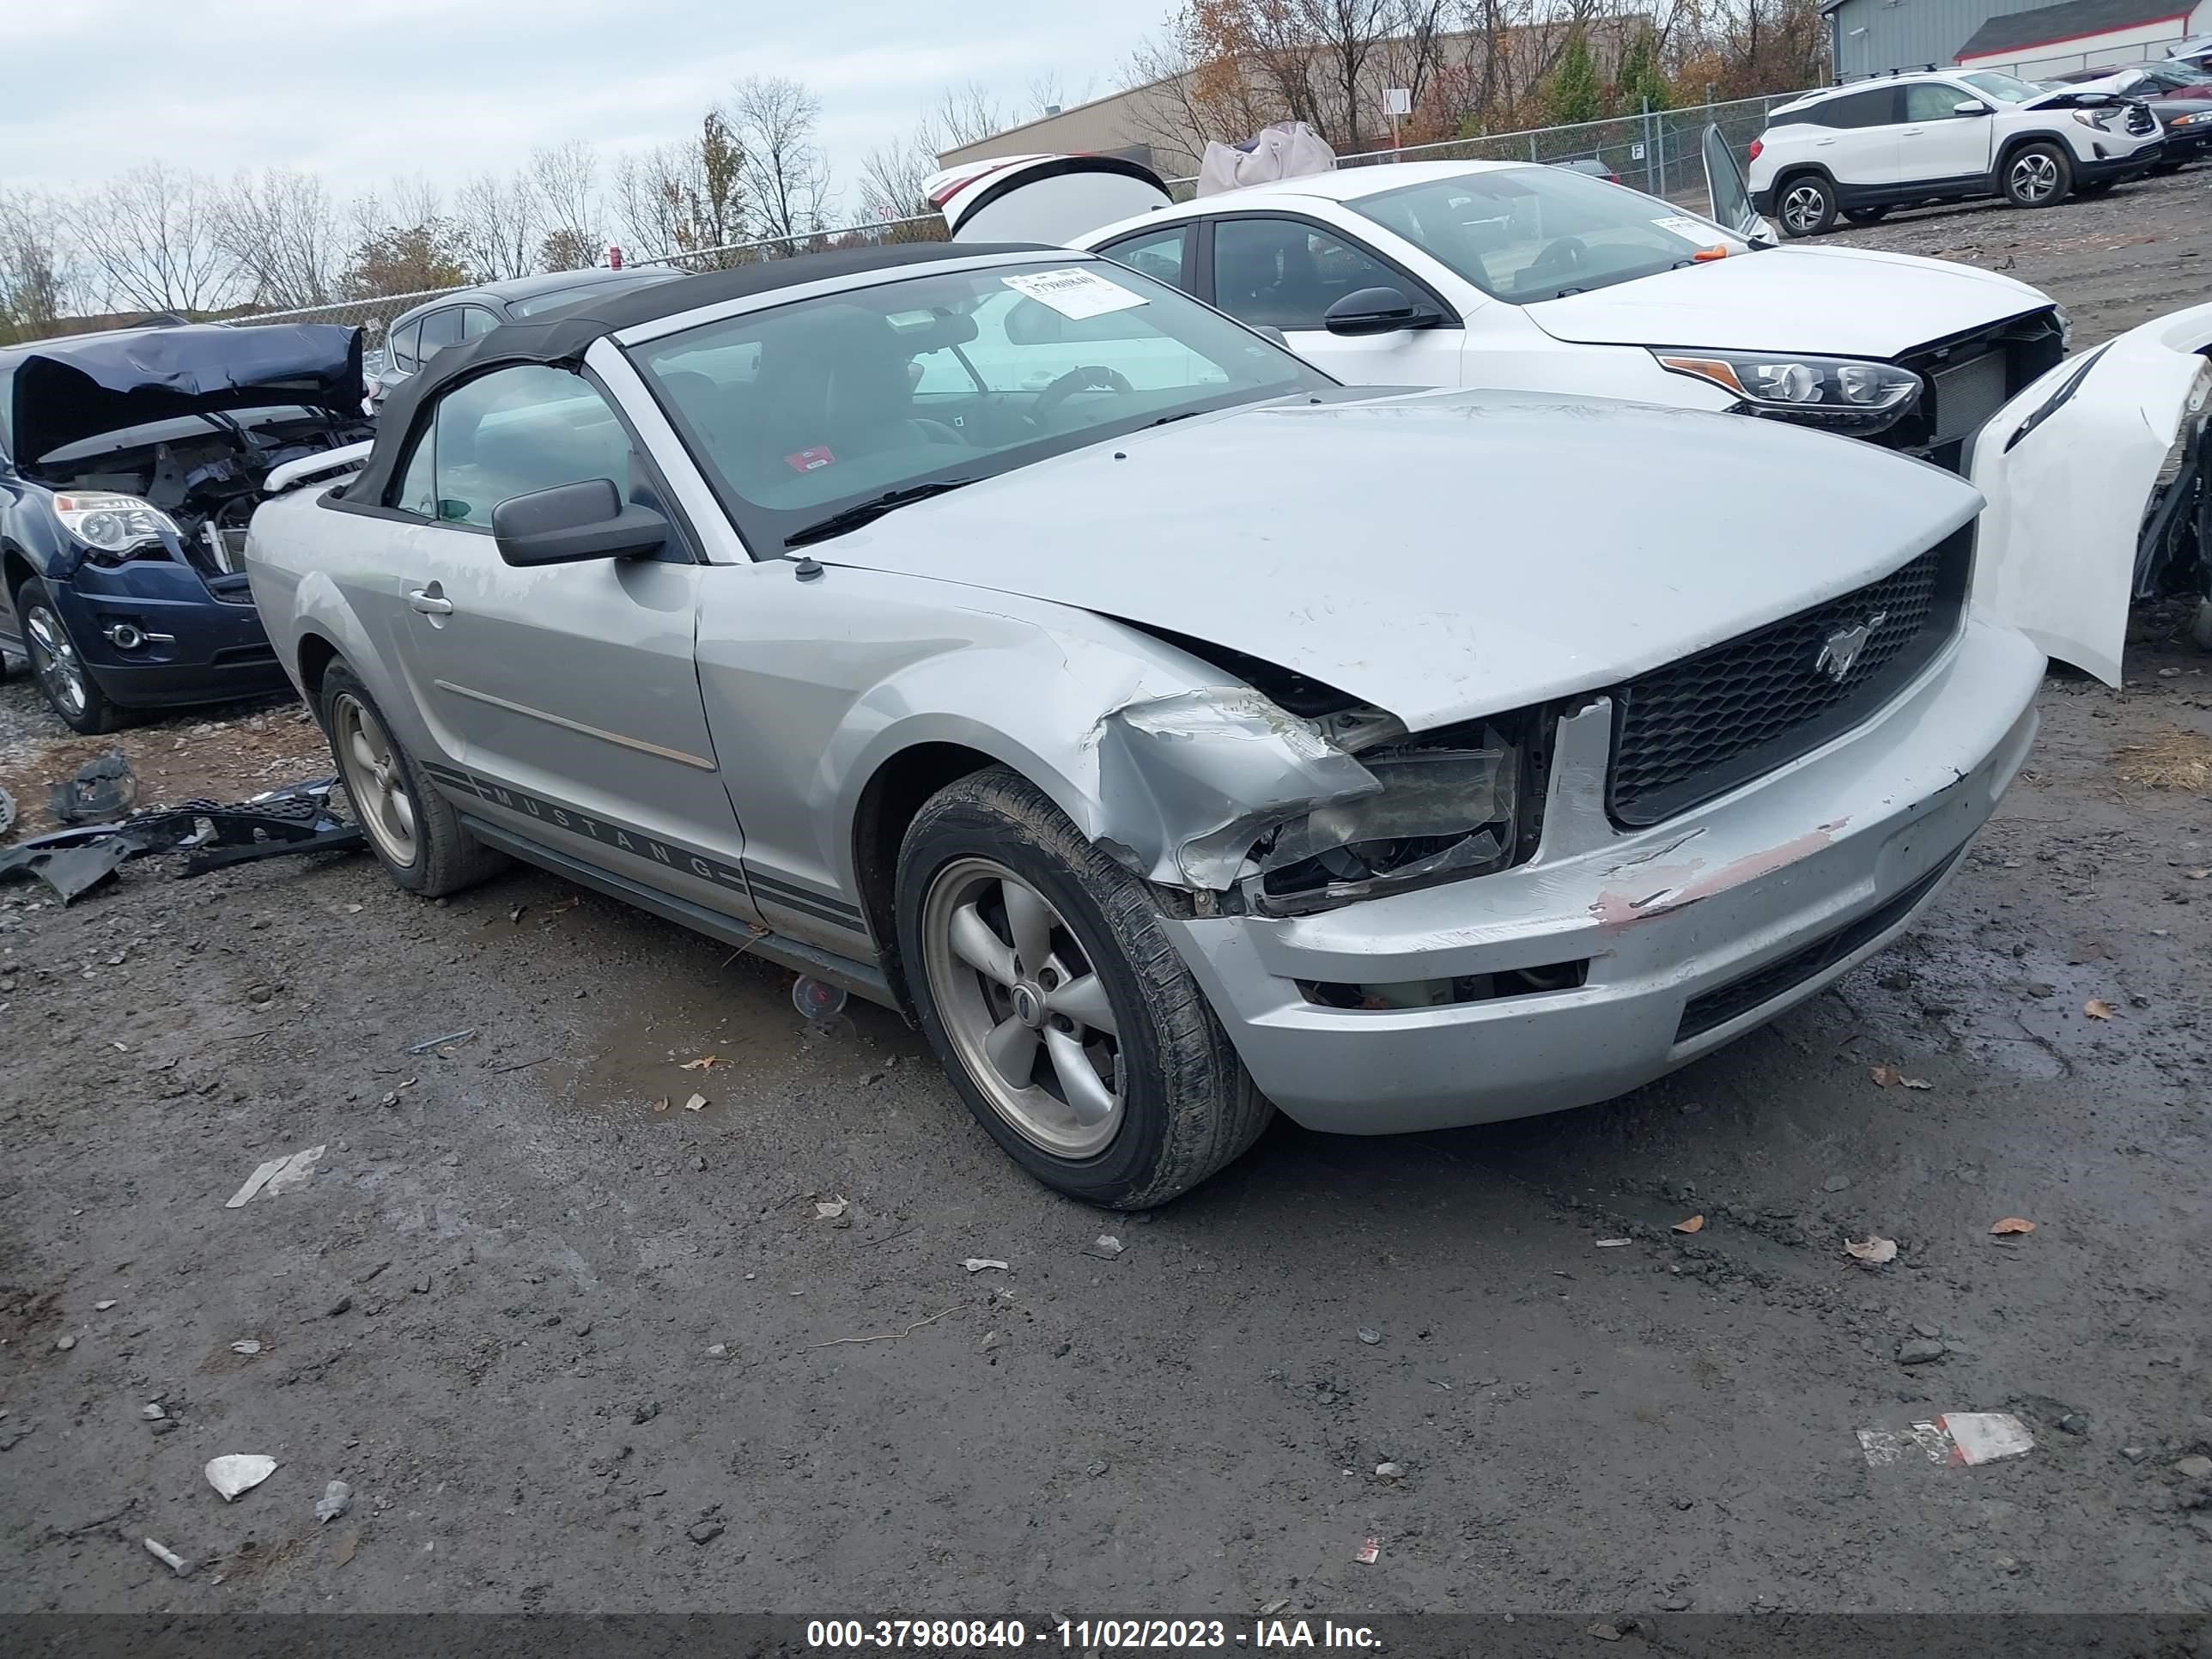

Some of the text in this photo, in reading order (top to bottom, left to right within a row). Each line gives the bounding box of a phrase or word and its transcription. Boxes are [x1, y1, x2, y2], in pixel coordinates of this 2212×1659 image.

[1634, 146, 1641, 158] F
[878, 205, 893, 222] 50
[494, 787, 714, 879] MUSTANG
